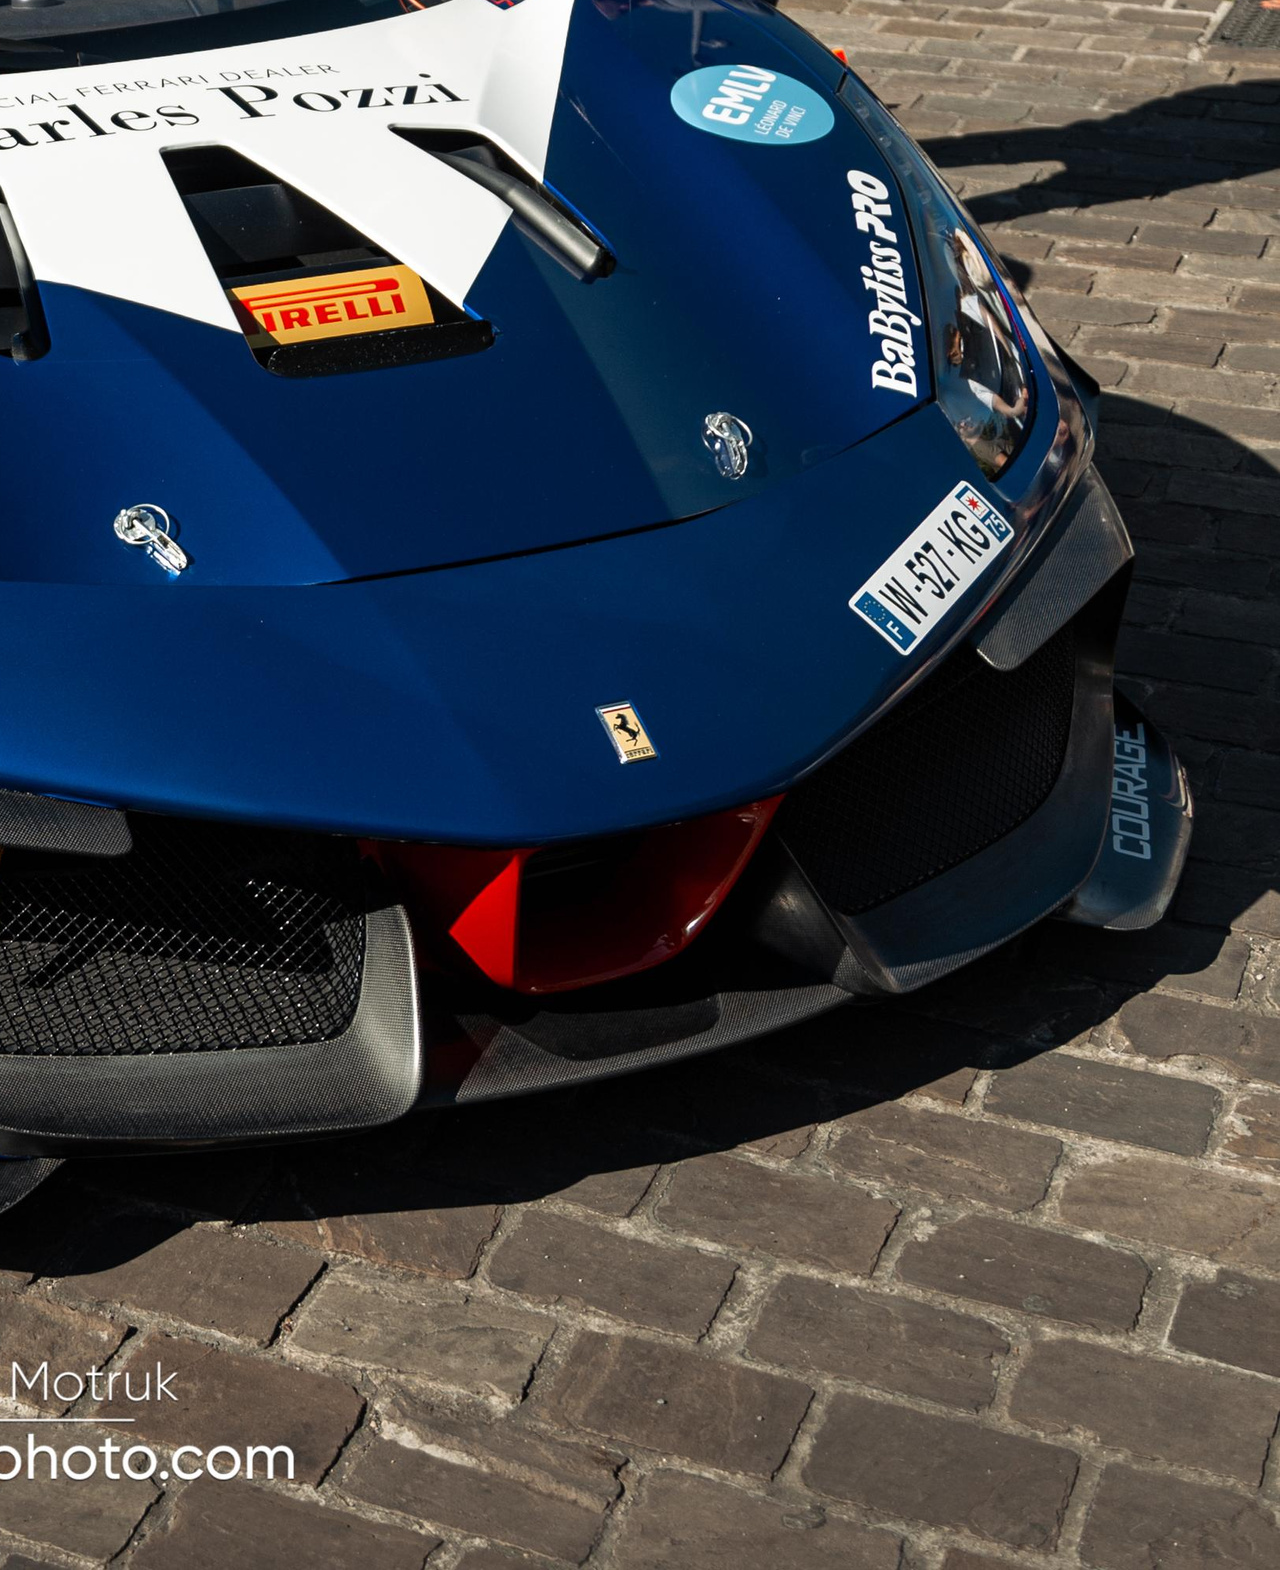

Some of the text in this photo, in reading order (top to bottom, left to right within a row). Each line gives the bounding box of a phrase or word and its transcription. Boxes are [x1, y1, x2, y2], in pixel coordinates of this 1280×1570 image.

[75, 74, 209, 98] FERRARI
[220, 64, 341, 82] DEALER
[205, 72, 470, 120] Pozzi
[702, 64, 777, 126] EMLV
[755, 100, 787, 134] LÉONARD
[775, 106, 806, 138] DE VINCI
[846, 169, 922, 398] BaByliss PRO
[230, 277, 407, 336] PIRELLI
[984, 513, 1007, 538] 75
[885, 620, 903, 641] F
[1111, 722, 1152, 860] COURAGE
